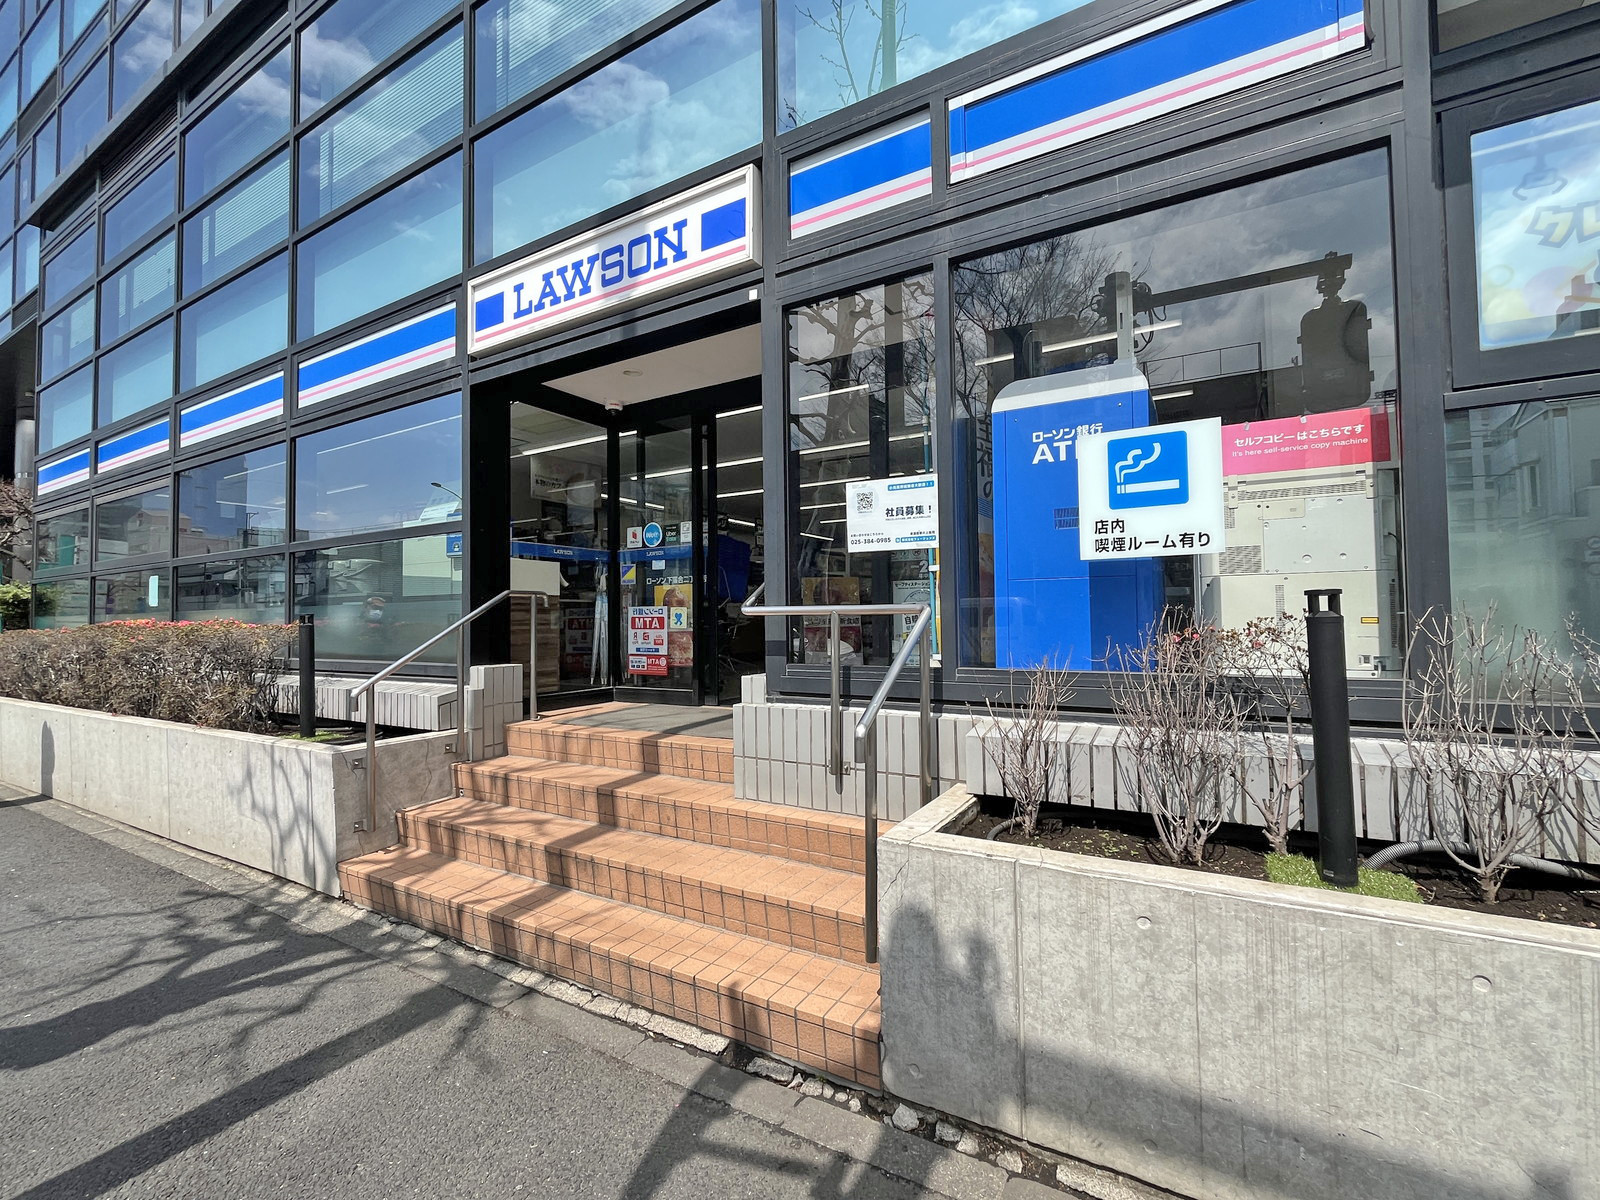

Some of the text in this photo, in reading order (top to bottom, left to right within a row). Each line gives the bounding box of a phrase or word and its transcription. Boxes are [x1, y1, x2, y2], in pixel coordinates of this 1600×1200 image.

[513, 218, 688, 320] LAWSON
[1032, 422, 1104, 443] ローソン銀行
[1233, 423, 1365, 447] セルフコピーはこちらです
[1031, 440, 1078, 465] AT
[1244, 448, 1262, 456] here
[1311, 441, 1331, 451] copy
[1332, 436, 1369, 447] machine
[1094, 518, 1126, 536] 店内
[1094, 531, 1211, 554] 喫煙ルーム有り
